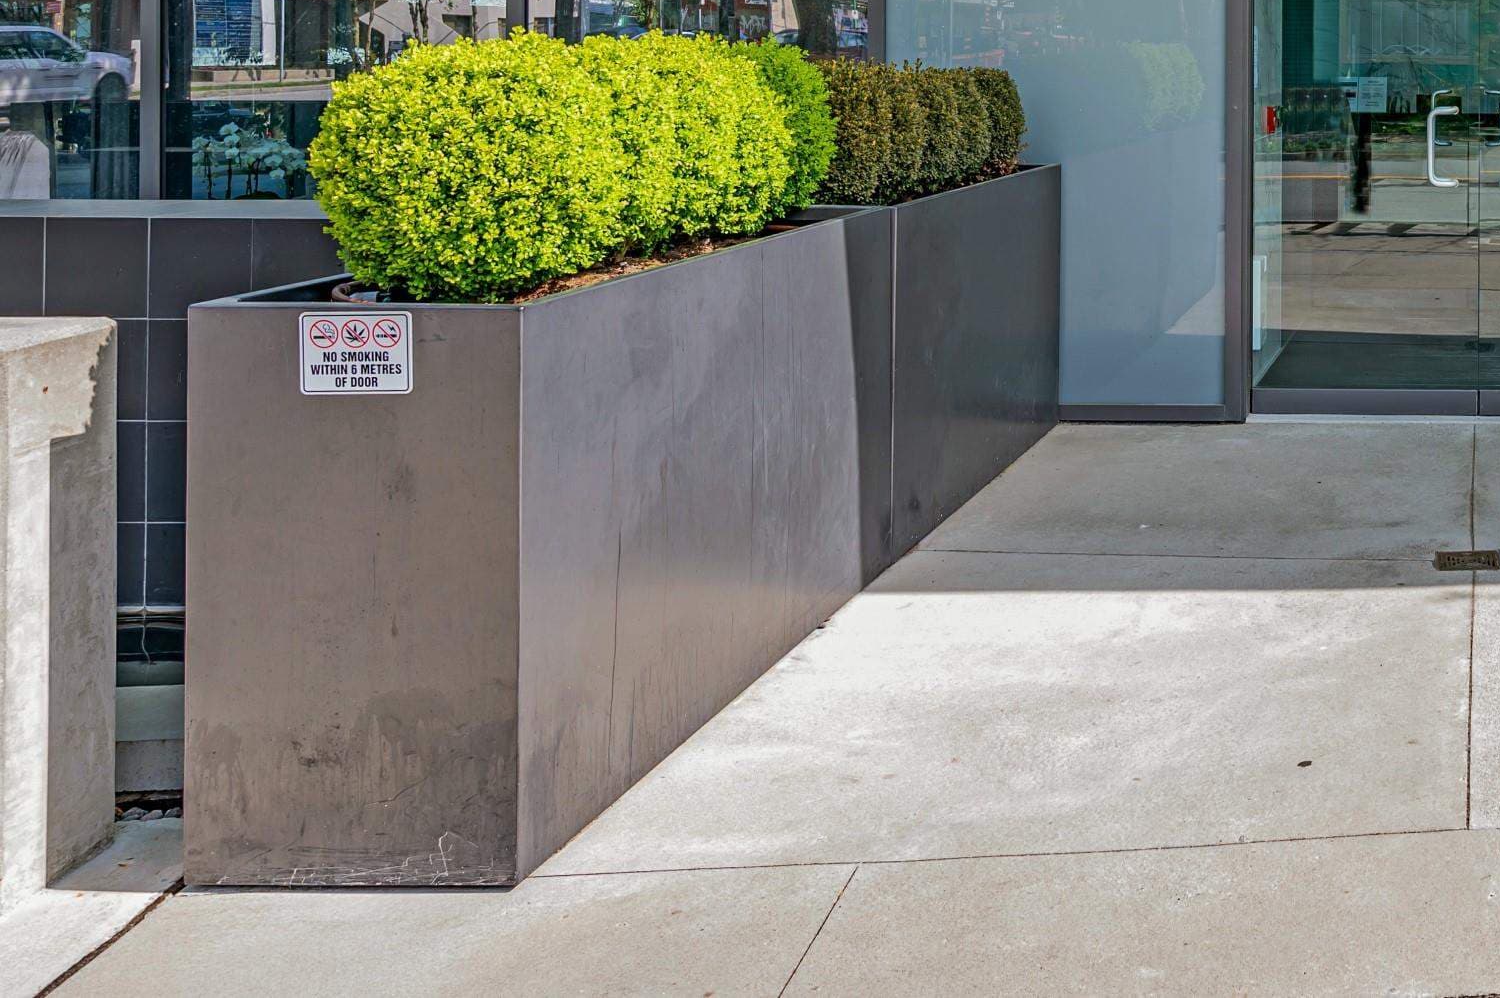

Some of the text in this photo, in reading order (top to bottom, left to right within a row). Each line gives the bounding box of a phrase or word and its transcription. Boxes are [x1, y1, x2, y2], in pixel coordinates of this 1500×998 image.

[322, 351, 390, 363] NO SMOKING
[311, 364, 402, 375] WITHIN 6 METRES
[335, 377, 378, 388] OF DOOR
